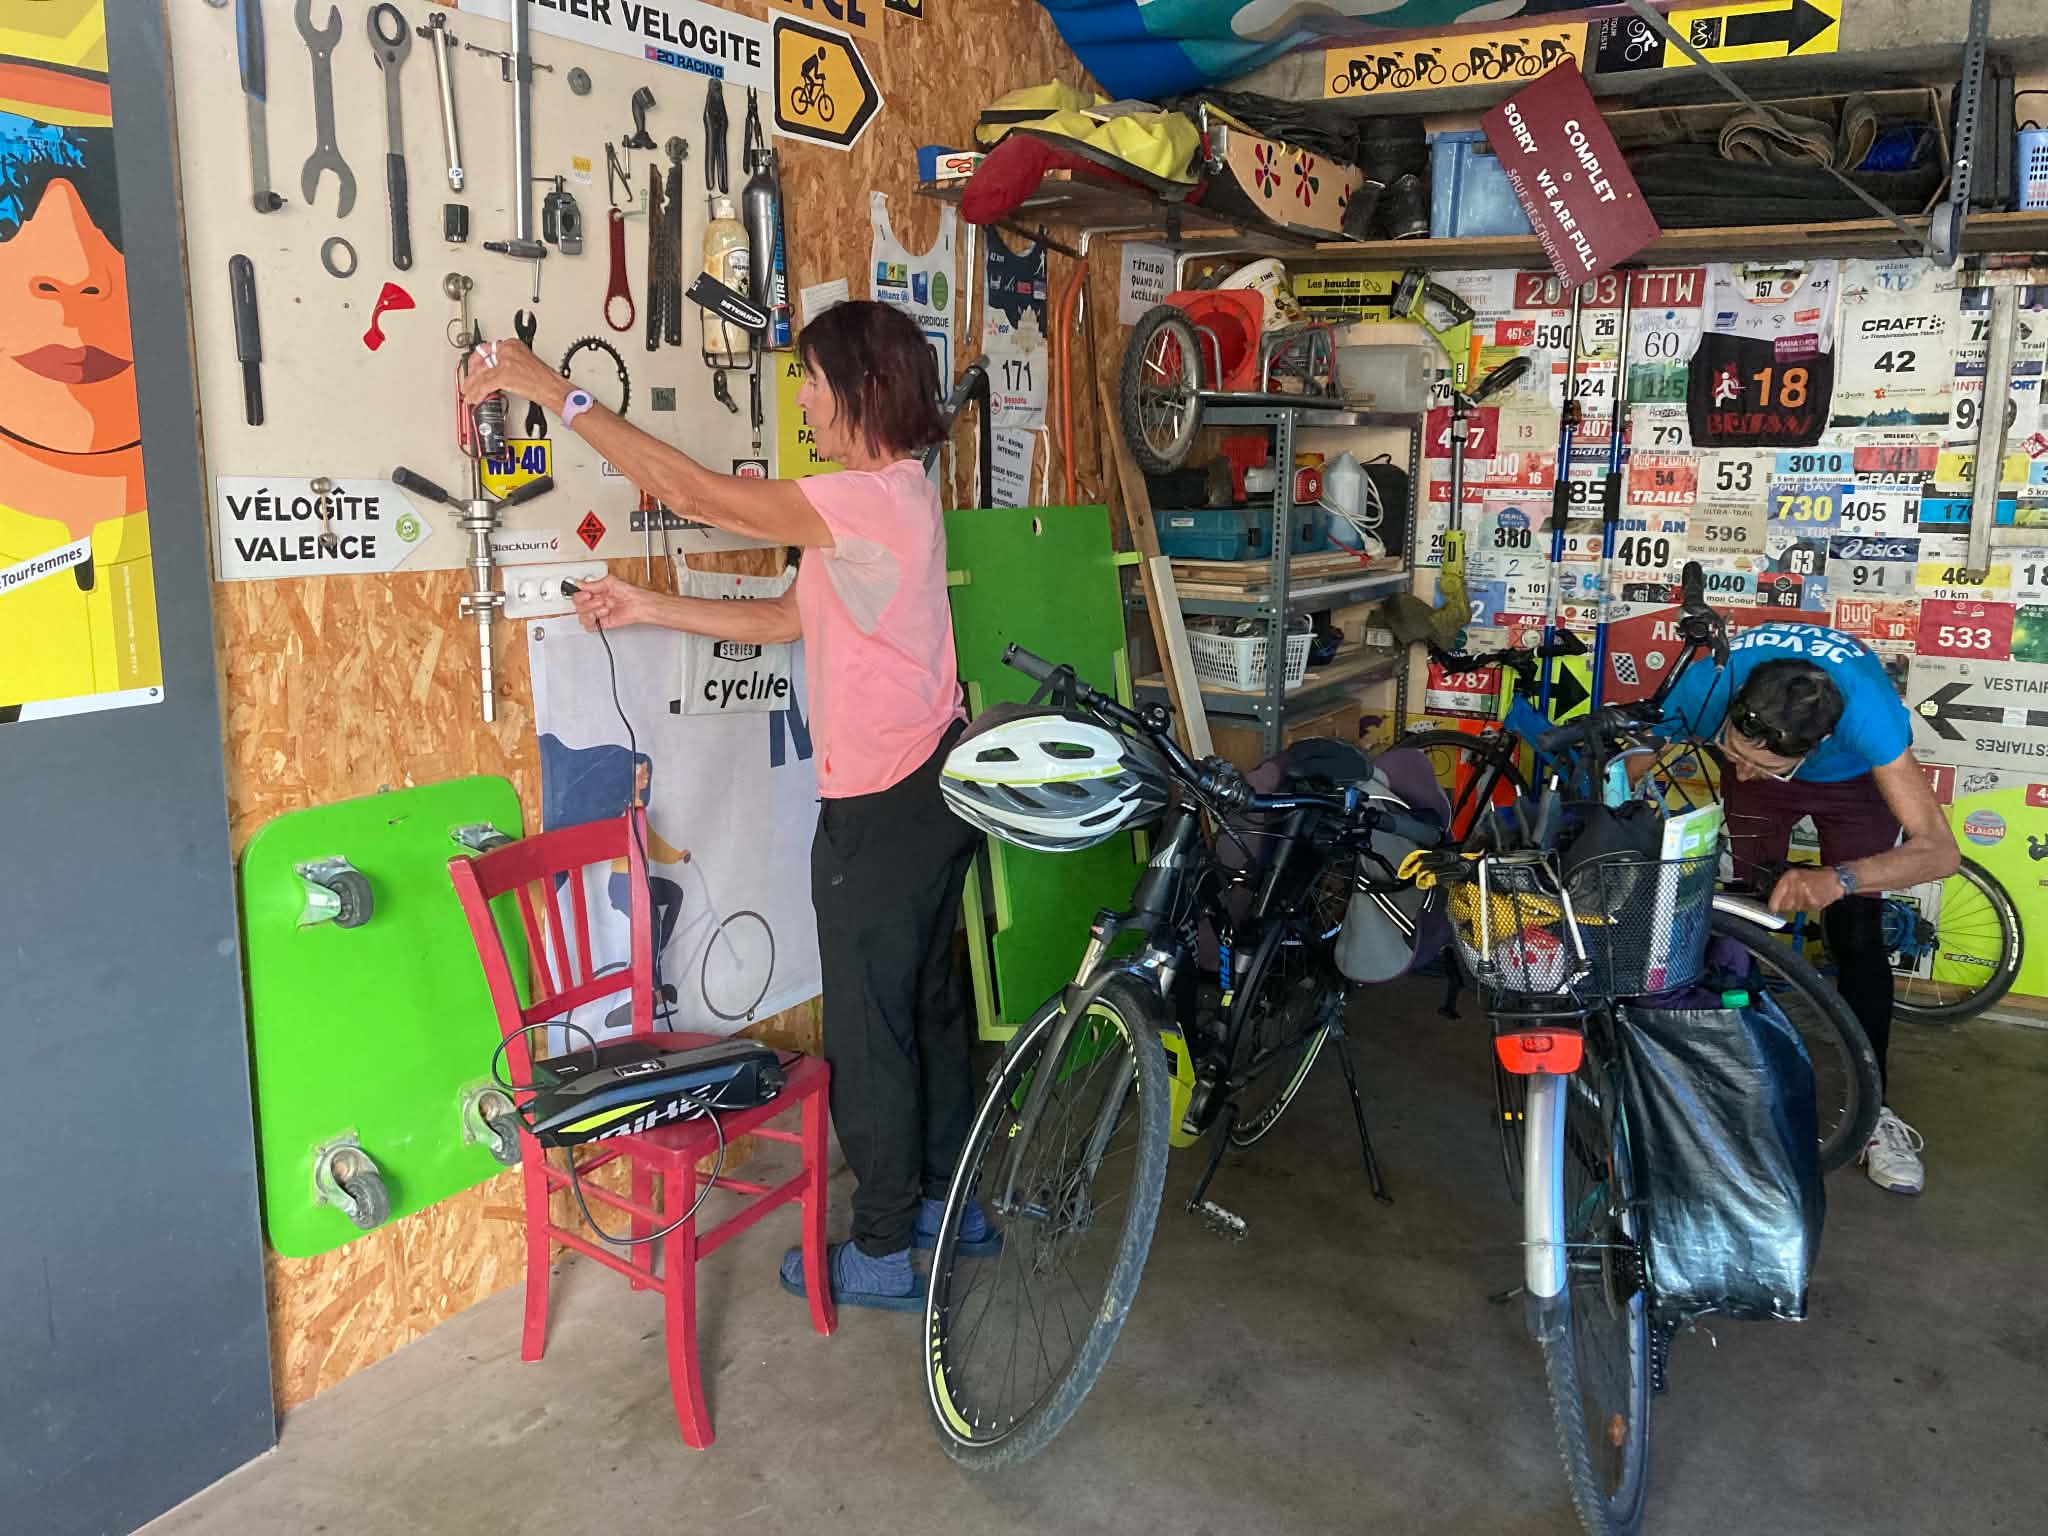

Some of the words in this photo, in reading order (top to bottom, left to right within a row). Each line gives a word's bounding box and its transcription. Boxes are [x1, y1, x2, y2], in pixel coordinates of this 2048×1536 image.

[621, 1, 761, 68] VELOGITE
[1610, 17, 1618, 37] TOUR
[677, 55, 724, 79] RACING
[1504, 103, 1538, 156] SORRY
[1563, 119, 1617, 204] COMPLET
[1506, 168, 1529, 199] SAUF
[1536, 168, 1560, 199] WE
[1549, 198, 1577, 232] ARE
[1567, 227, 1599, 272] FULL
[775, 274, 786, 305] TIRE
[1131, 275, 1153, 287] QUAND
[1638, 273, 1697, 304] TTW
[1755, 281, 1772, 297] 157
[720, 300, 763, 324] SCHWALBE
[1595, 318, 1615, 337] 26
[1861, 316, 1928, 332] CRAFT
[1536, 324, 1572, 349] 590
[1644, 331, 1680, 358] 60
[1874, 350, 1916, 374] 42
[1002, 359, 1033, 392] 171
[1752, 367, 1809, 408] 18
[1437, 427, 1485, 449] 47
[1518, 425, 1533, 438] 13
[1653, 426, 1683, 446] 79
[486, 445, 547, 475] WD-40
[1788, 454, 1842, 473] 3010
[740, 468, 762, 479] BELL
[1527, 471, 1543, 485] 16
[1655, 470, 1674, 486] 54
[1716, 460, 1753, 492] 53
[226, 488, 380, 522] VÉLOGÎTE
[1632, 489, 1696, 505] TRAILS
[1775, 495, 1833, 522] 730
[1840, 501, 1887, 522] 405
[1903, 499, 1919, 524] H
[1494, 527, 1532, 549] 380
[1705, 525, 1747, 542] 596
[234, 535, 377, 562] VALENCE
[1618, 536, 1670, 568] 469
[1861, 539, 1908, 559] asics
[0, 545, 84, 591] TourFemmes
[1504, 558, 1524, 577] 2
[1790, 549, 1815, 575] 63
[1852, 565, 1887, 588] 91
[1527, 583, 1546, 594] 101
[1934, 589, 1947, 599] 10
[1950, 589, 1969, 599] km
[1518, 615, 1540, 626] 487
[1581, 608, 1597, 620] 48
[1840, 604, 1872, 624] DUO
[1888, 623, 1905, 637] 10
[1937, 625, 1992, 650] 533
[723, 644, 754, 656] SERIES
[1728, 632, 1803, 653] VOIS
[1807, 639, 1856, 665] JE
[704, 671, 789, 709] cyclite
